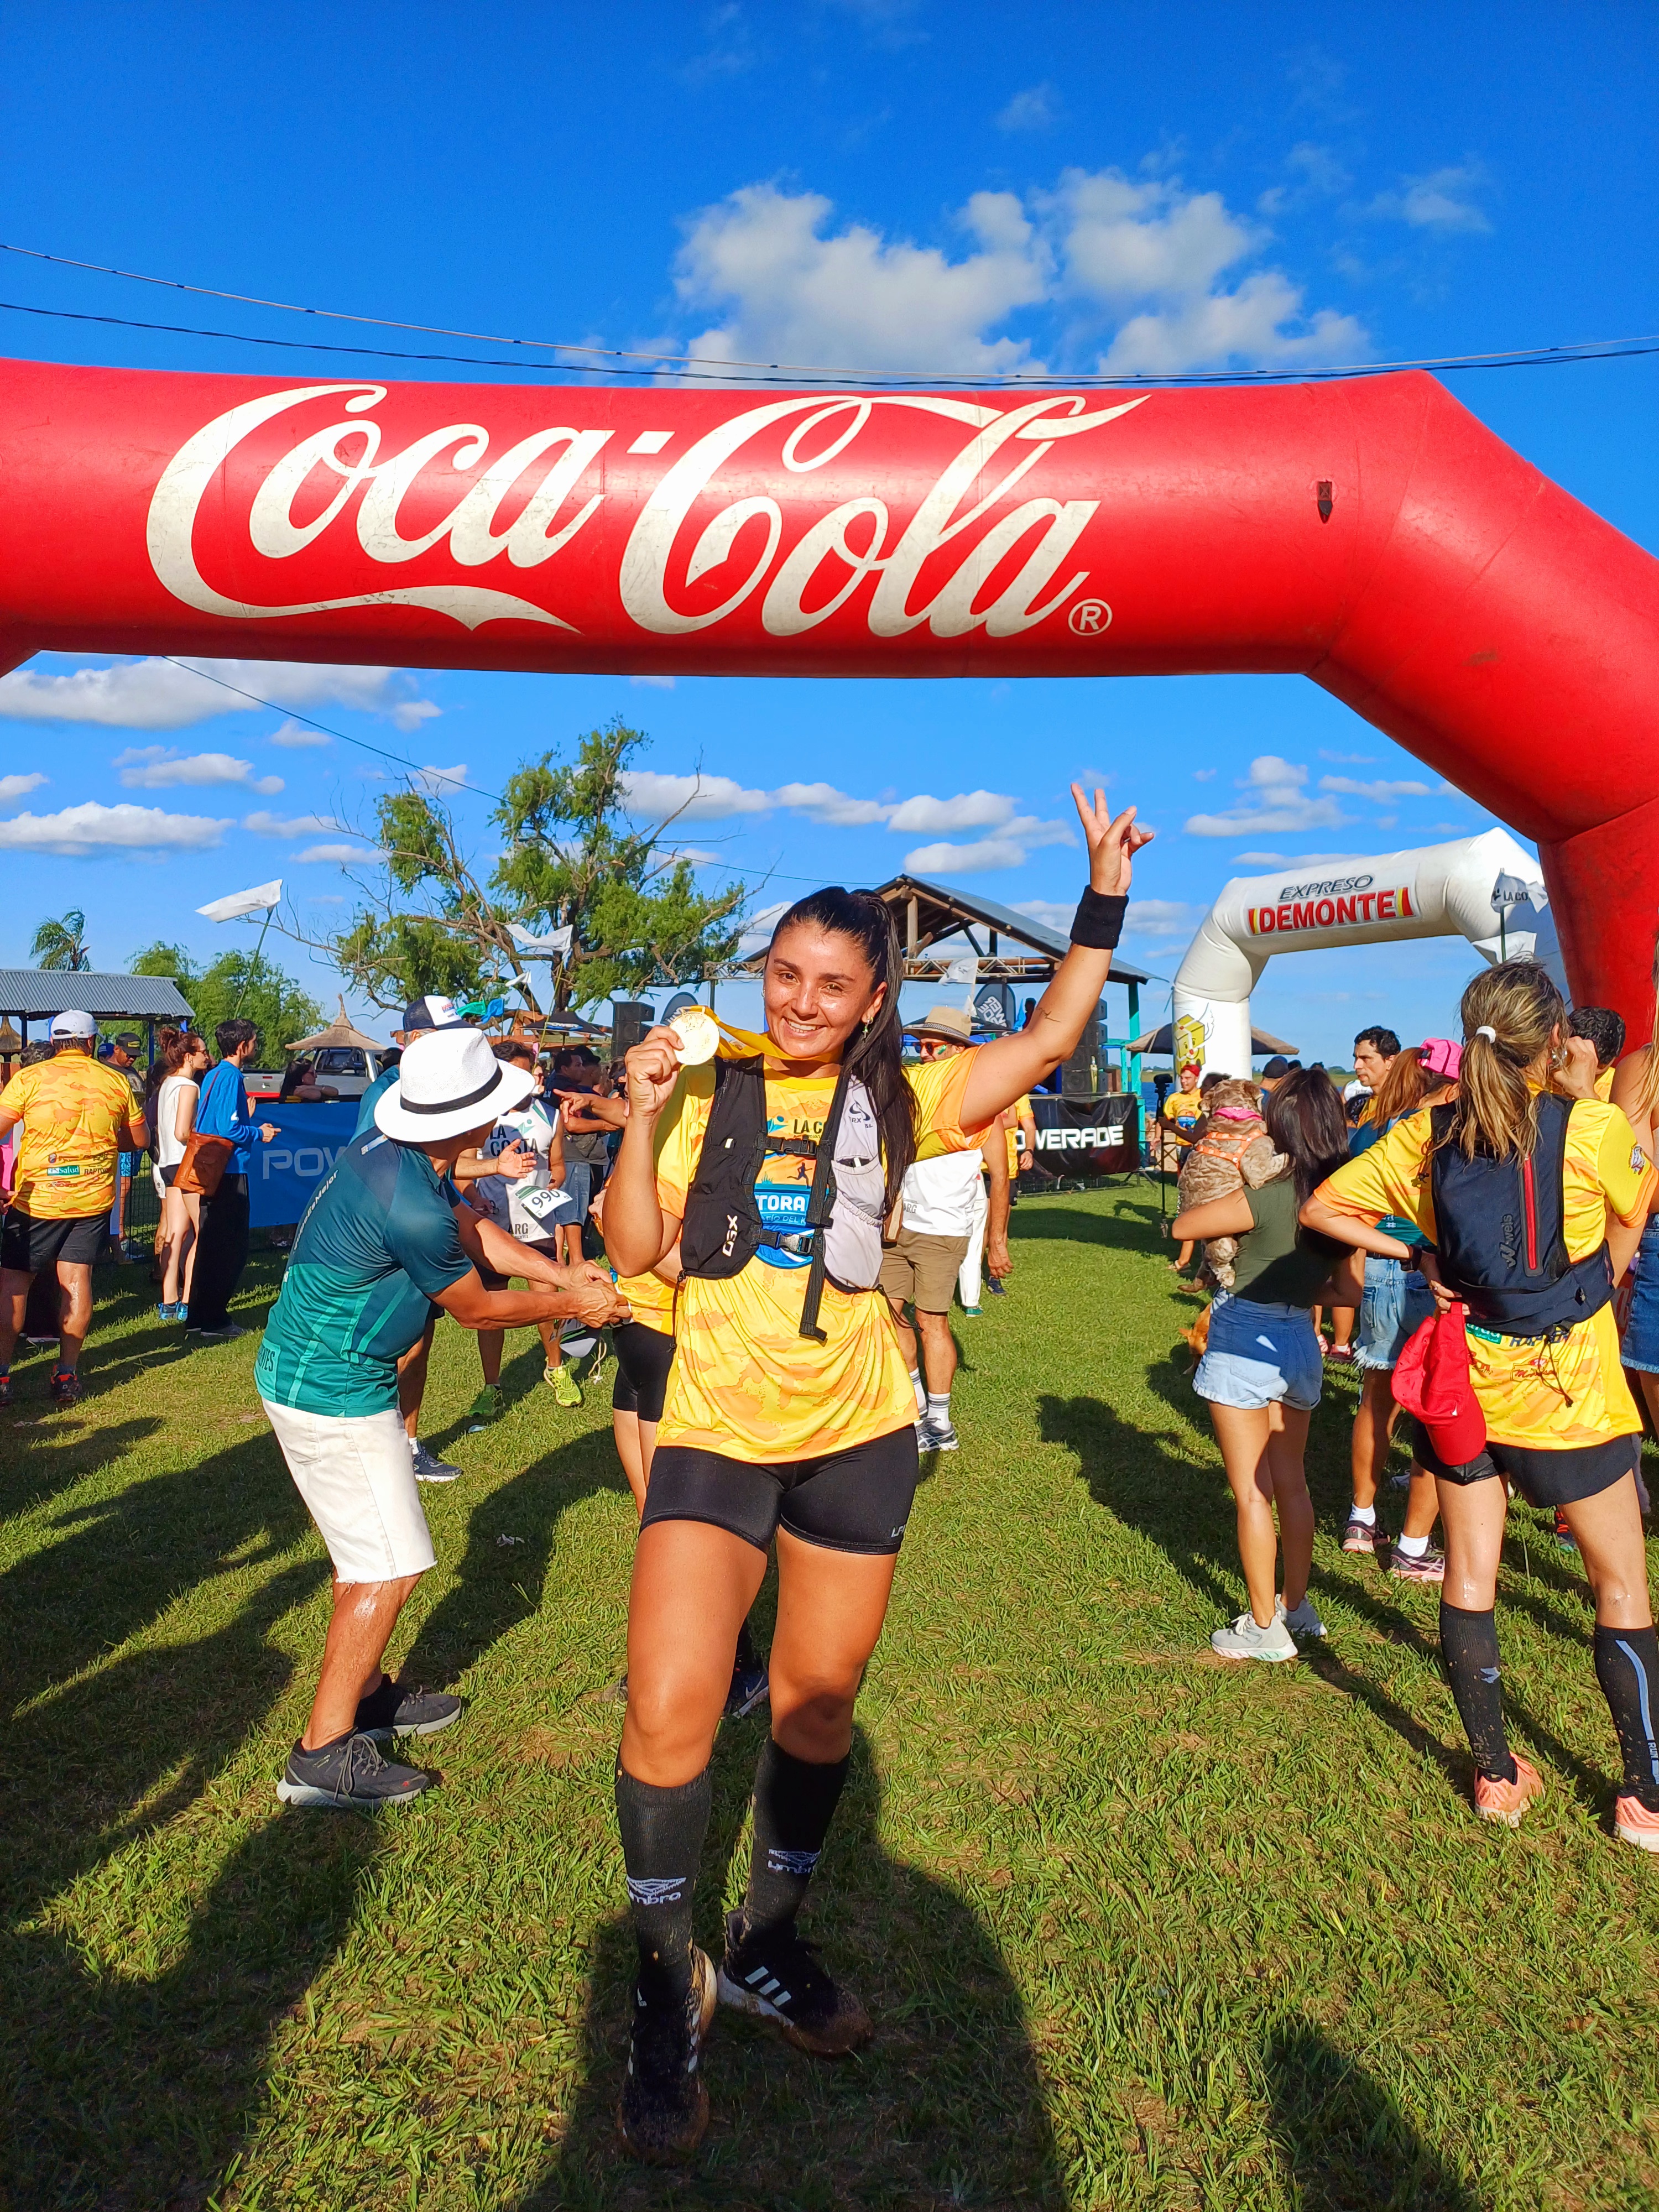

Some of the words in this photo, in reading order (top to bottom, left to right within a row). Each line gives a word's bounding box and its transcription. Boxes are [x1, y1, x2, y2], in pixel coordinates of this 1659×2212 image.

[147, 383, 1149, 638] Coca-Cola
[1279, 875, 1374, 901] EXPRESO
[1503, 890, 1514, 901] LA
[1515, 891, 1529, 901] CO
[1259, 889, 1396, 932] DEMONTE
[490, 1124, 507, 1139] LA
[794, 1119, 810, 1134] LA
[531, 1189, 561, 1208] 990
